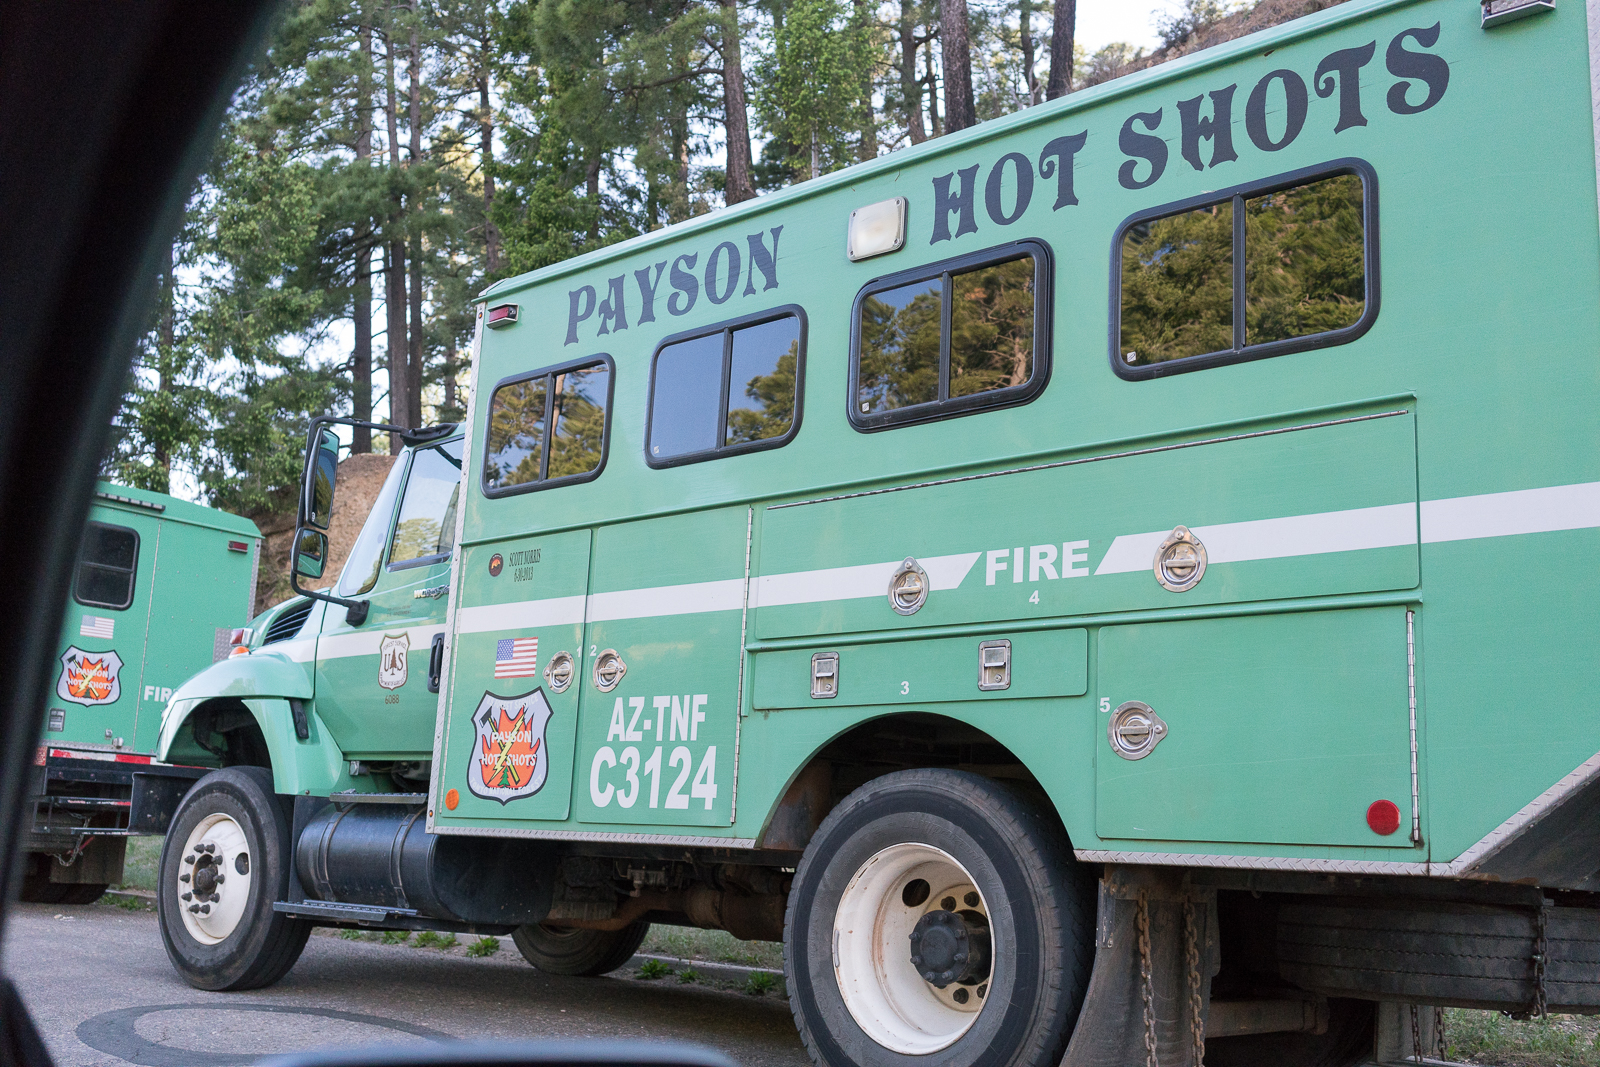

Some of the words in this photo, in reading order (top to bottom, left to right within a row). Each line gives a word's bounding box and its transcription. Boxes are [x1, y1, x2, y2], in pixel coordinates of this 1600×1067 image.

[564, 224, 784, 347] PAYSON
[929, 129, 1088, 245] HOT
[1118, 21, 1450, 191] SHOTS
[509, 551, 524, 567] SCOTT
[524, 548, 542, 565] NORRIS
[985, 539, 1090, 586] FIRE
[1029, 590, 1040, 606] 4
[576, 646, 581, 658] 1
[590, 645, 597, 657] 2
[68, 678, 82, 686] HOT
[88, 681, 112, 690] SHOTS
[900, 680, 910, 695] 3
[143, 685, 176, 703] FIR
[385, 694, 399, 705] 6088
[1099, 697, 1111, 713] 5
[606, 694, 708, 742] AZ-TNF
[491, 730, 532, 743] PAYSON
[481, 753, 500, 766] HOT
[506, 753, 537, 766] SHOTS
[590, 745, 718, 810] C3124
